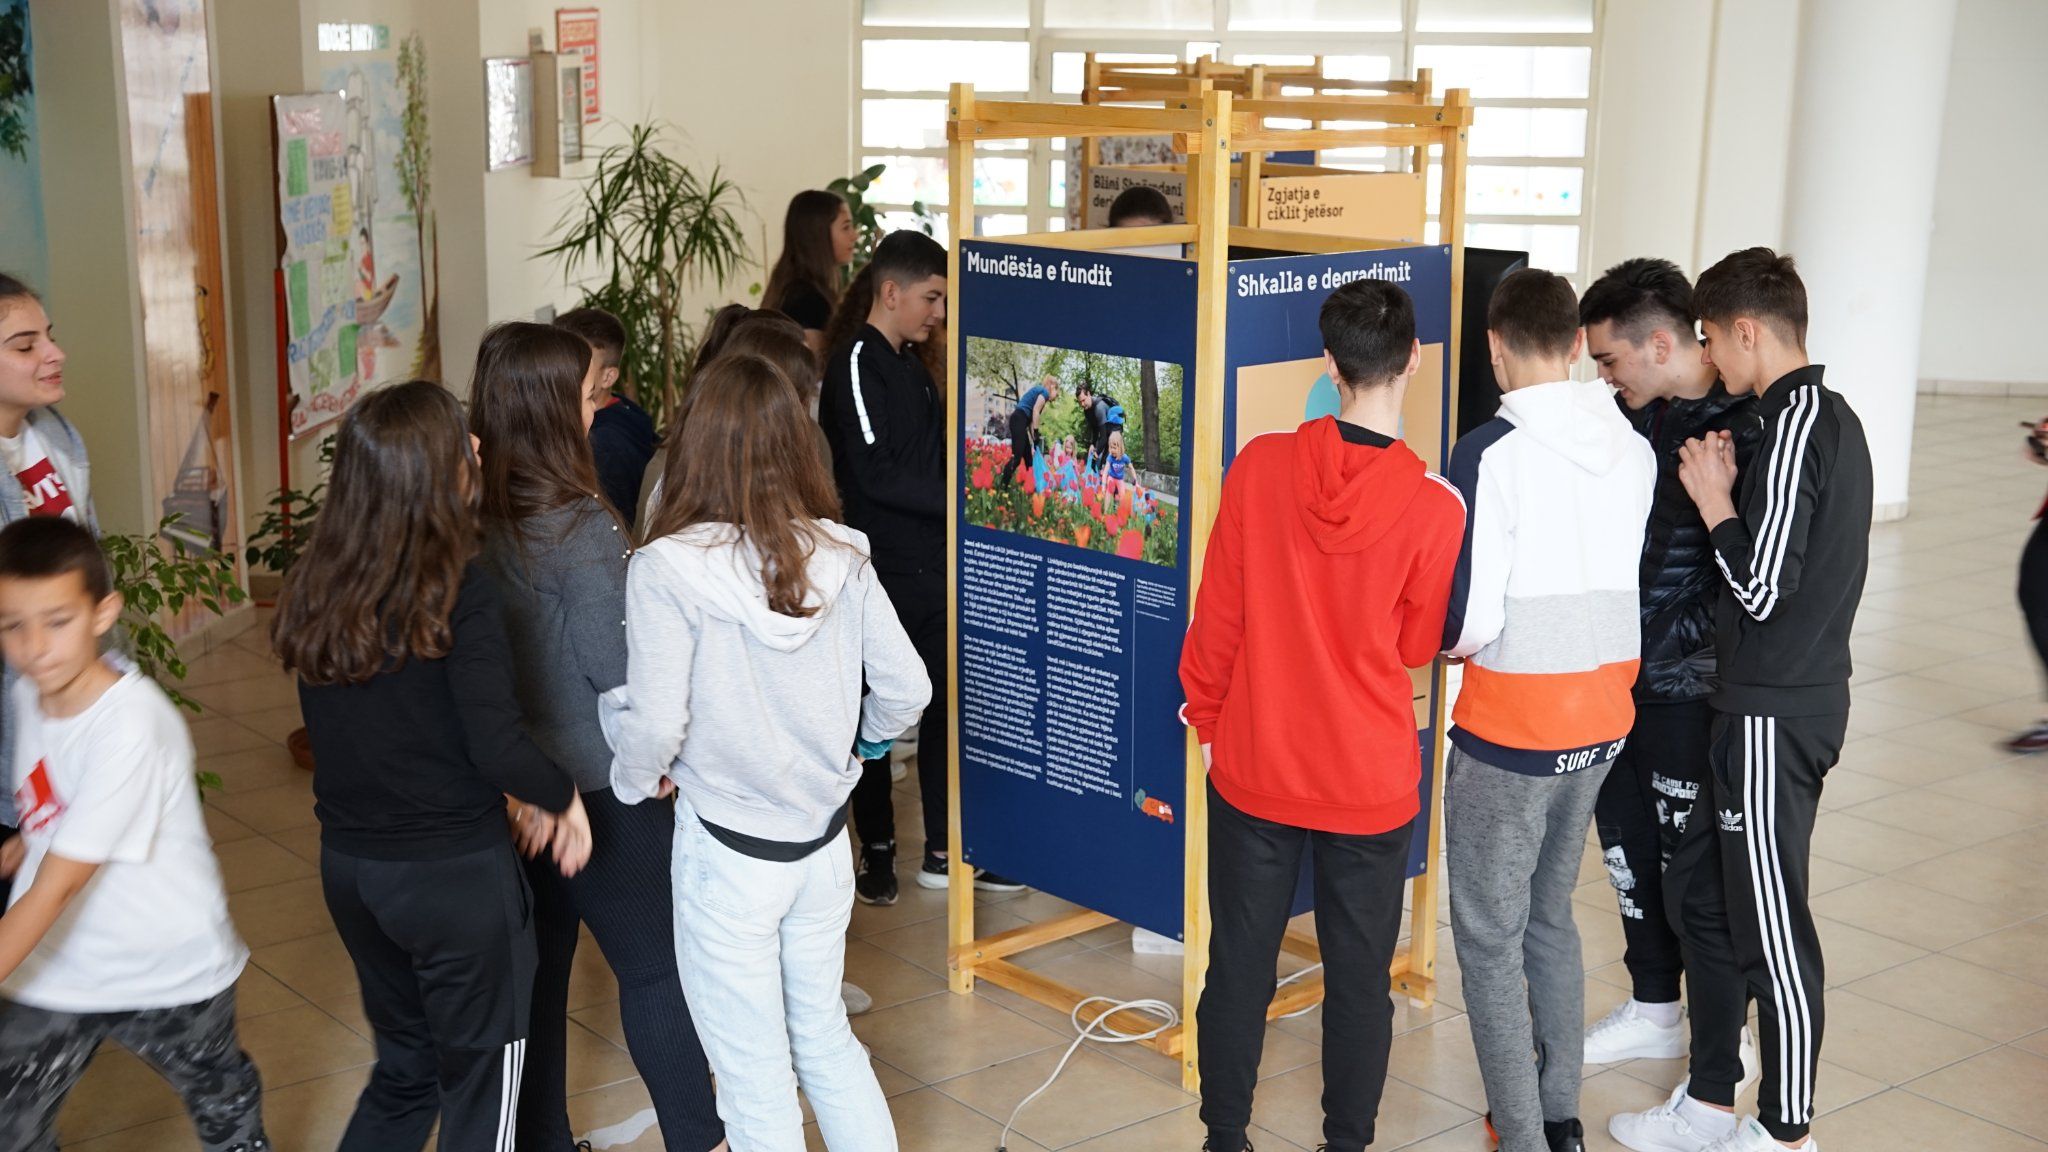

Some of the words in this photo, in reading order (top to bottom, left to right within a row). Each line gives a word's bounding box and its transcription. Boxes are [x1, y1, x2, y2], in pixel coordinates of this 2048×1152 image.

[1093, 174, 1119, 190] Blini
[1267, 186, 1310, 206] Zgjatja
[1313, 189, 1320, 200] e
[1267, 206, 1301, 221] ciklit
[1302, 204, 1344, 222] jetësor
[967, 251, 1042, 279] Mundësia
[1046, 264, 1057, 281] e
[1061, 260, 1113, 287] fundit
[1237, 270, 1303, 297] Shkalla
[1307, 277, 1318, 291] e
[1555, 747, 1600, 774] SURF
[1720, 824, 1743, 832] adidas
